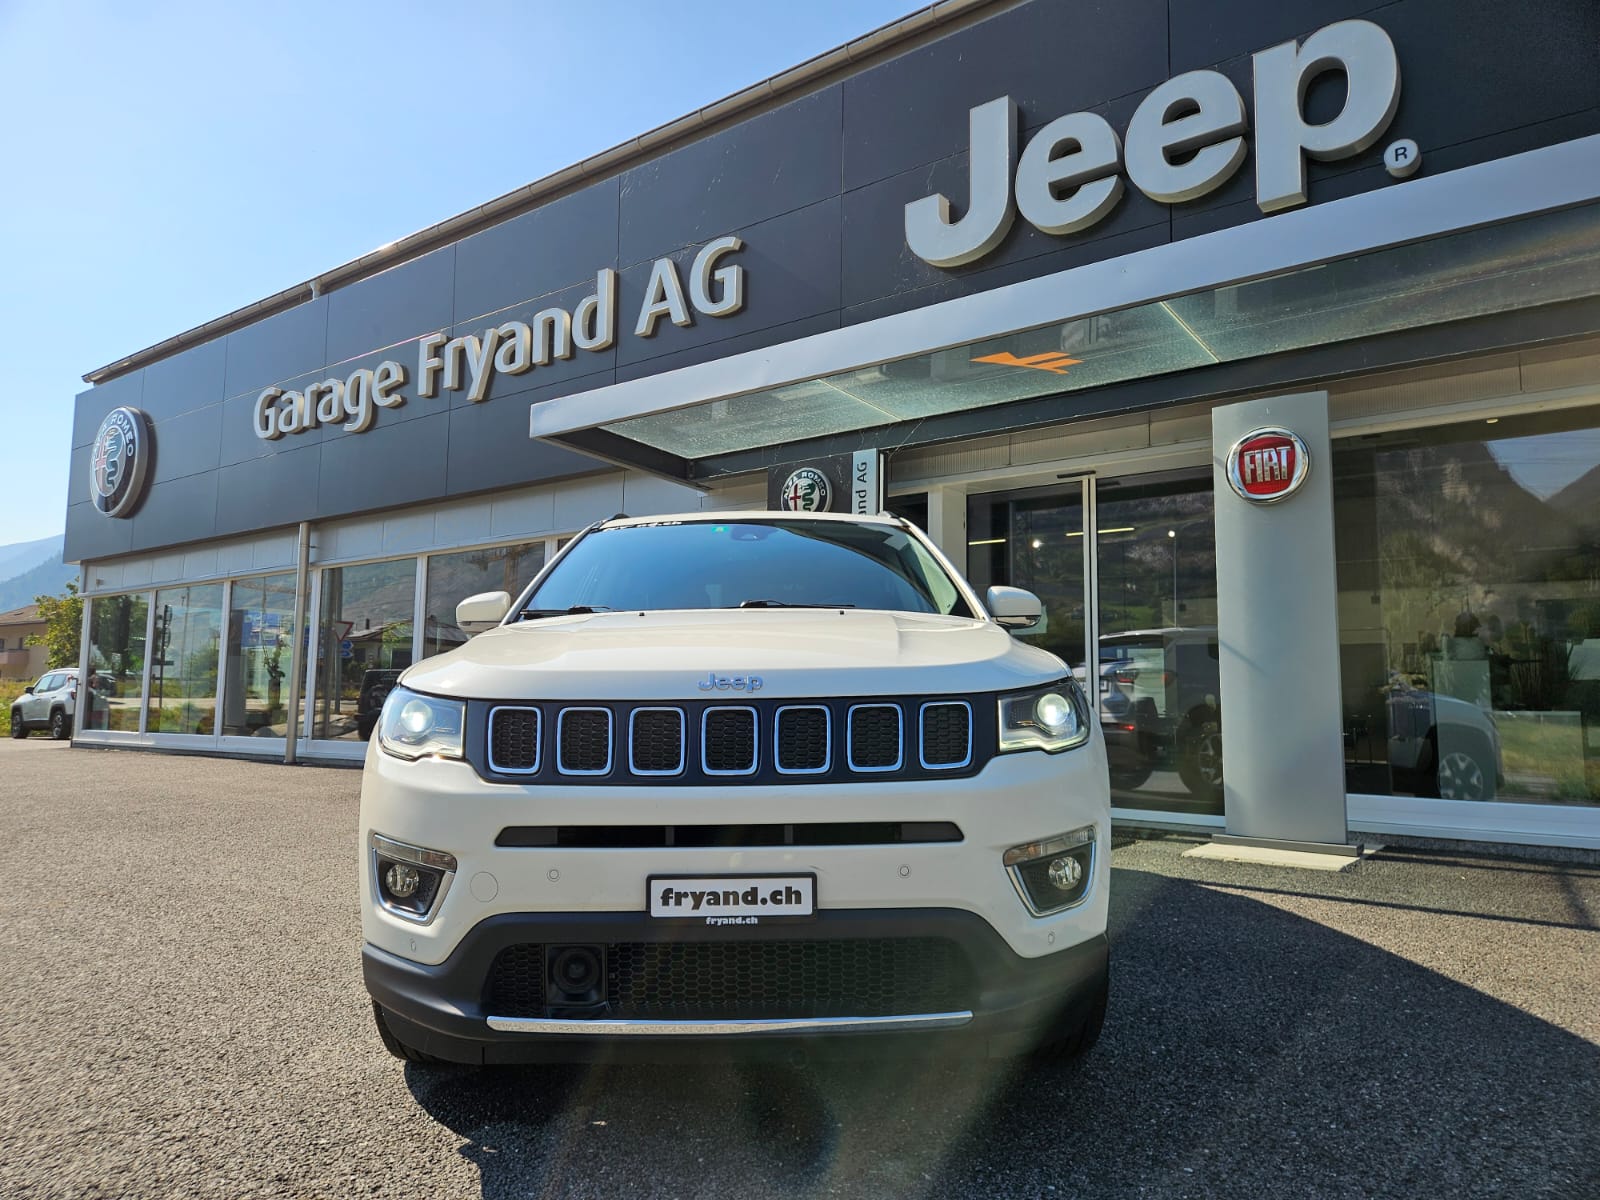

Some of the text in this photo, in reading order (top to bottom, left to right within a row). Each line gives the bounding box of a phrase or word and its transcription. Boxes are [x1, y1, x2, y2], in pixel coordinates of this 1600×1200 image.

[905, 19, 1401, 267] Jeep
[254, 236, 743, 439] Garage Fryand AG
[111, 413, 135, 457] ROMEO
[856, 461, 868, 484] AG
[1244, 446, 1291, 484] FIAT
[697, 671, 764, 693] Jeep
[660, 885, 802, 911] fryand.ch
[705, 916, 758, 926] fryand.ch
